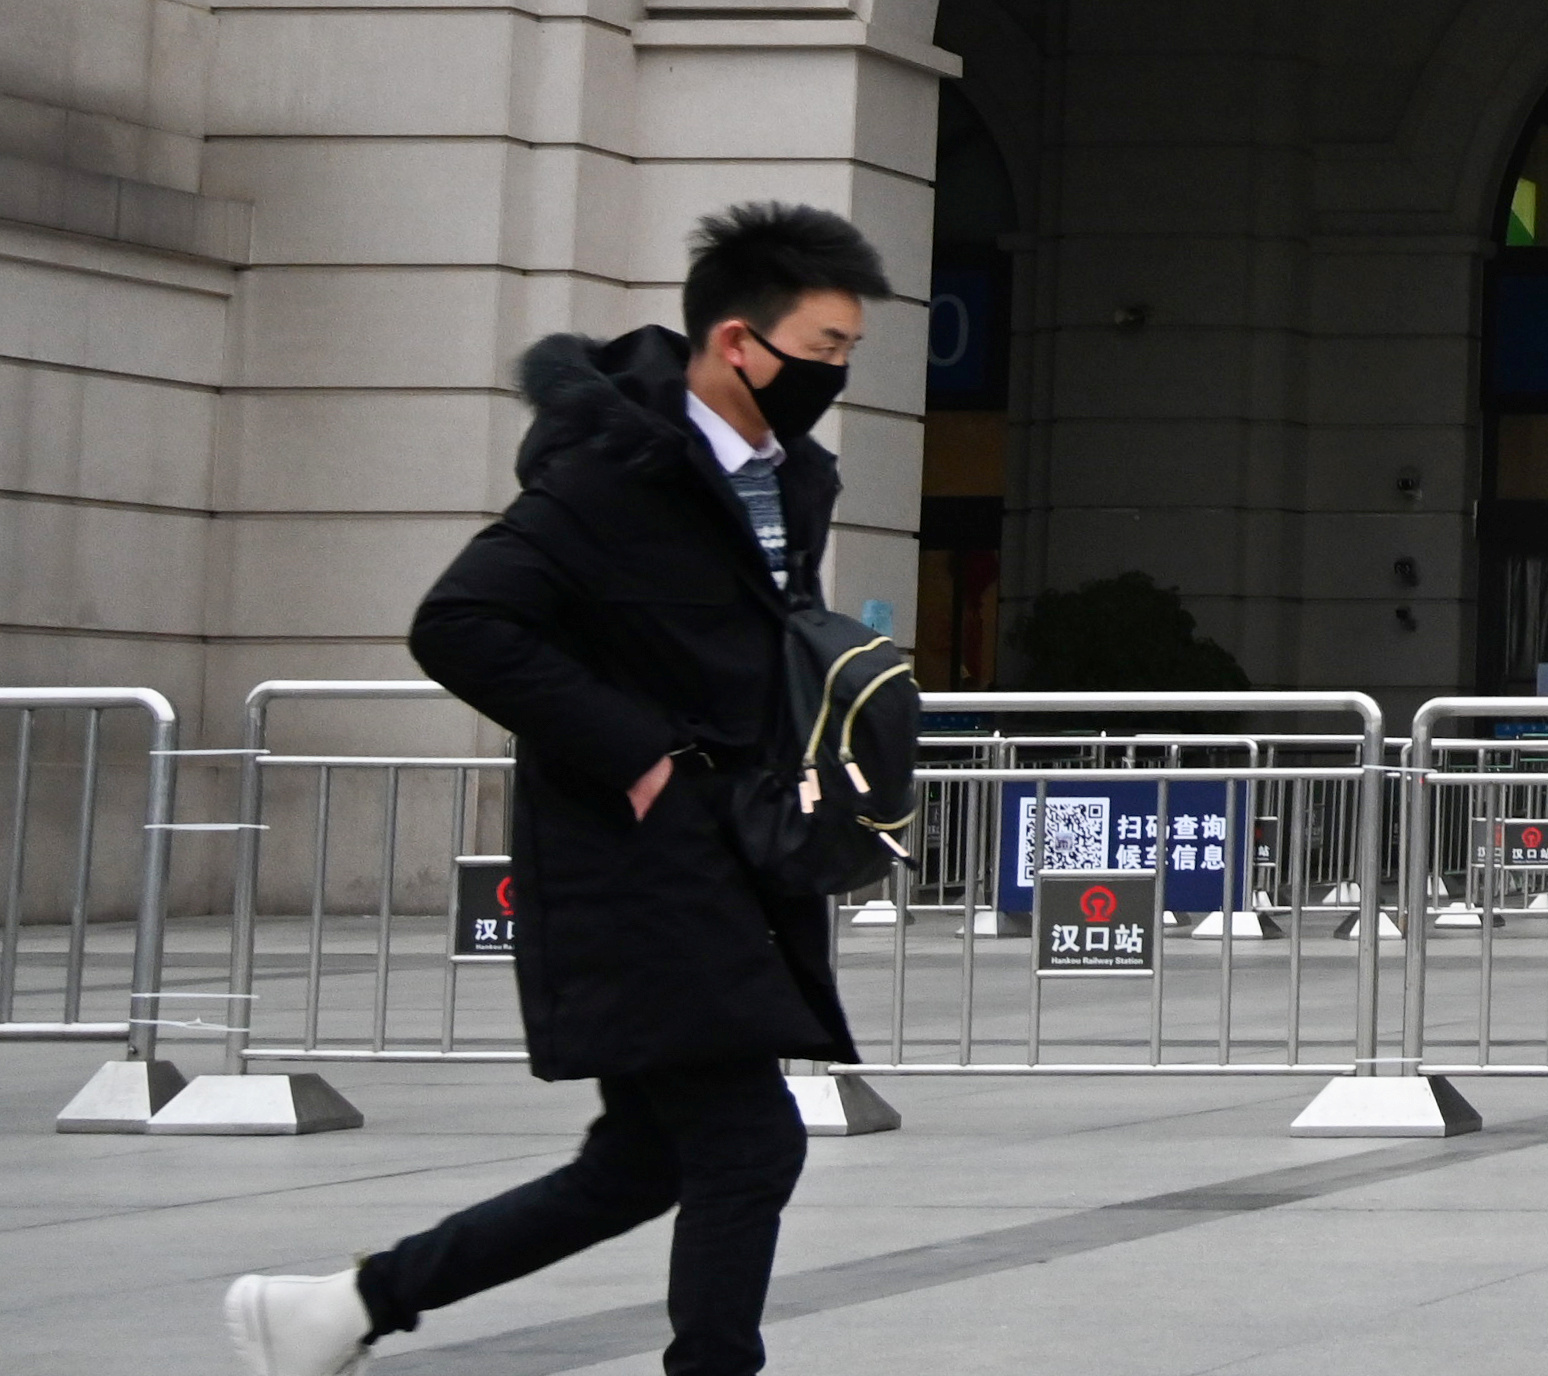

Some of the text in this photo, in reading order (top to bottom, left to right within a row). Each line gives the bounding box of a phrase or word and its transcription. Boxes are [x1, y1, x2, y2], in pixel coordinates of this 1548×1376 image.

[1116, 814, 1227, 840] 扫码查询
[1116, 844, 1226, 871] 候车信息
[1051, 924, 1144, 953] 汉口站
